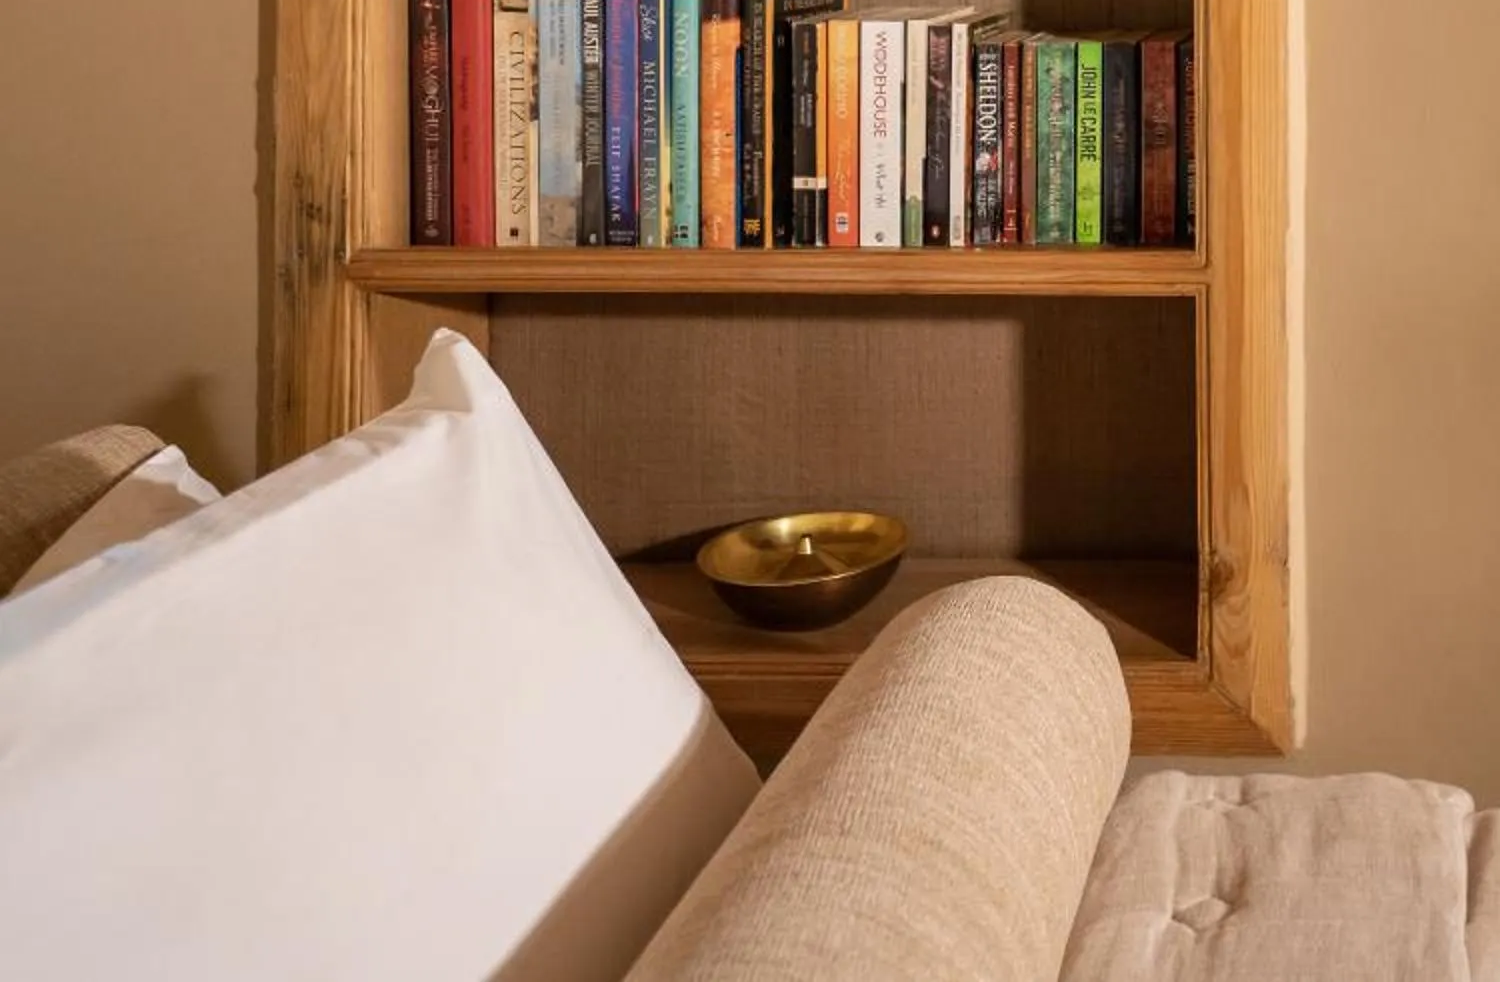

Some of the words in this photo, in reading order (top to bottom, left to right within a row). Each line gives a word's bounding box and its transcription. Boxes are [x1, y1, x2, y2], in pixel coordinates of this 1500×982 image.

[583, 21, 599, 64] AUSTER
[674, 11, 689, 78] NOON
[584, 68, 600, 113] WINTER
[642, 61, 657, 144] MICHAEL
[873, 31, 887, 138] WODEHOUSE
[979, 62, 997, 141] SHELDON
[1081, 63, 1097, 98] JOHN
[1084, 101, 1096, 115] LE
[510, 31, 527, 215] CIVILIZATIONS
[584, 115, 600, 167] JOURNAL
[643, 157, 657, 221] FRAYN
